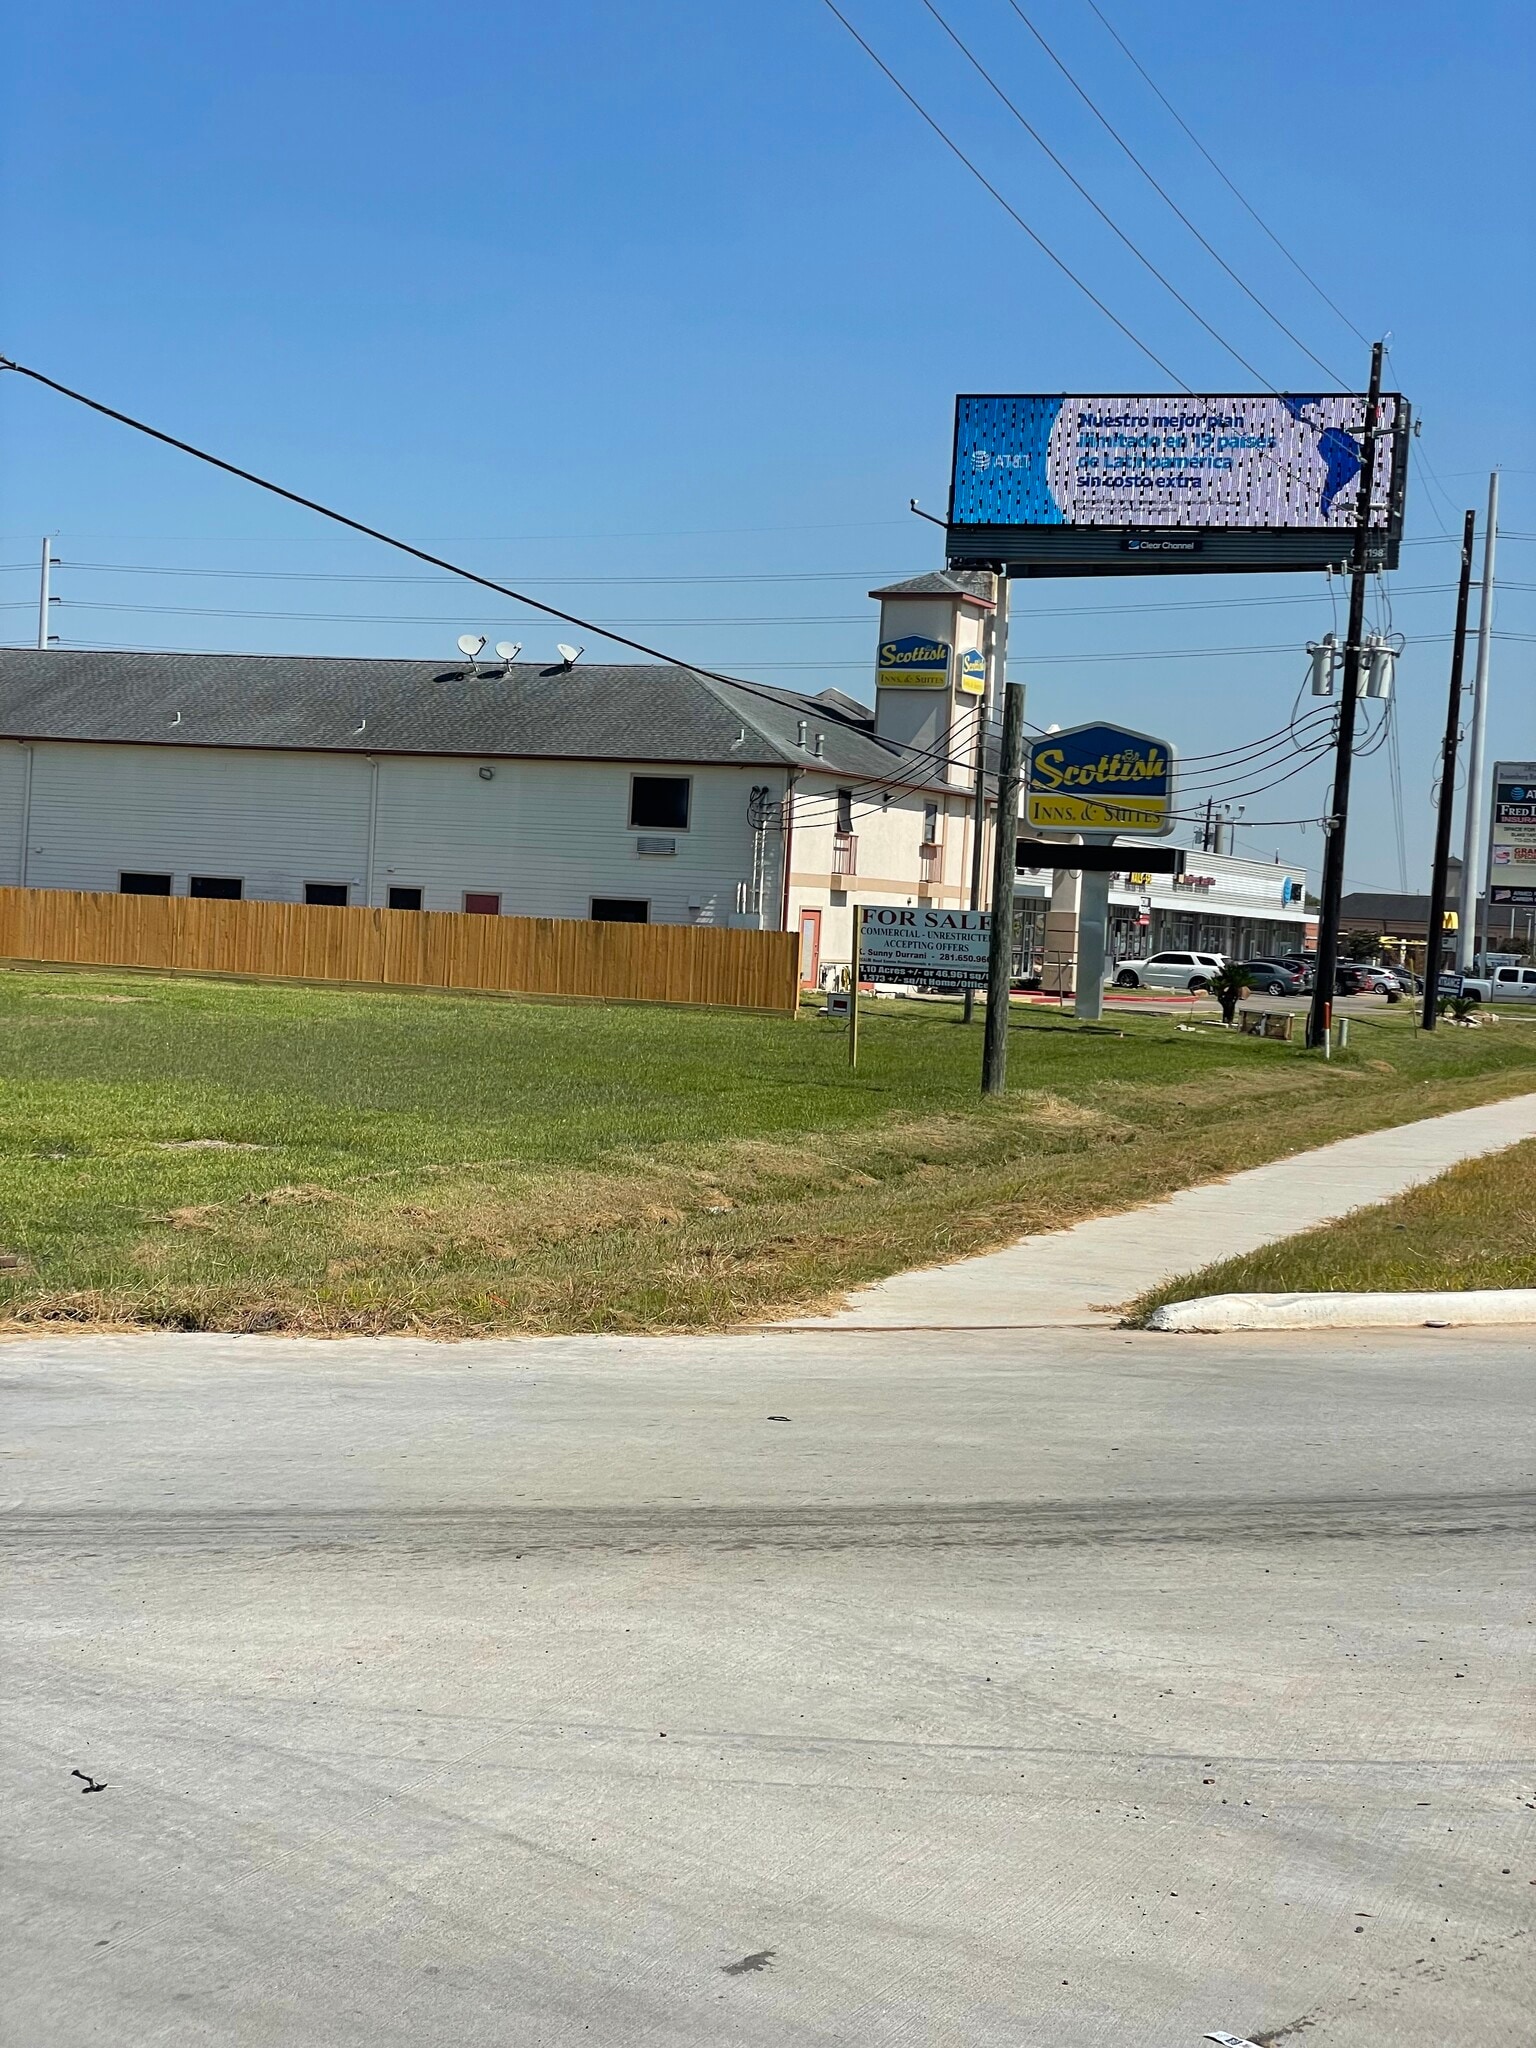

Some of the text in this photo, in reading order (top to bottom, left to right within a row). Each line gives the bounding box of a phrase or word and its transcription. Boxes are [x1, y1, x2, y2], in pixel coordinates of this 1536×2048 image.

[1078, 413, 1244, 431] Nuestro mejor plan
[1078, 432, 1161, 448] ilimitado
[1166, 435, 1188, 449] en
[1217, 431, 1277, 452] países
[1077, 452, 1234, 469] de Latinoamérica
[1076, 473, 1201, 488] sin costo extra
[1140, 541, 1194, 550] Clear Channel
[880, 644, 946, 666] Scottish
[1030, 748, 1166, 791] Scottish
[1501, 804, 1529, 816] FRED
[862, 909, 992, 931] FOR SALE
[860, 927, 920, 938] COMMERCIAL
[927, 931, 992, 943] UNRESTRICTE
[884, 940, 969, 952] ACCEPTING OFFERS
[868, 949, 893, 959] Sunny
[895, 950, 927, 960] Durrani
[878, 966, 906, 975] Acres
